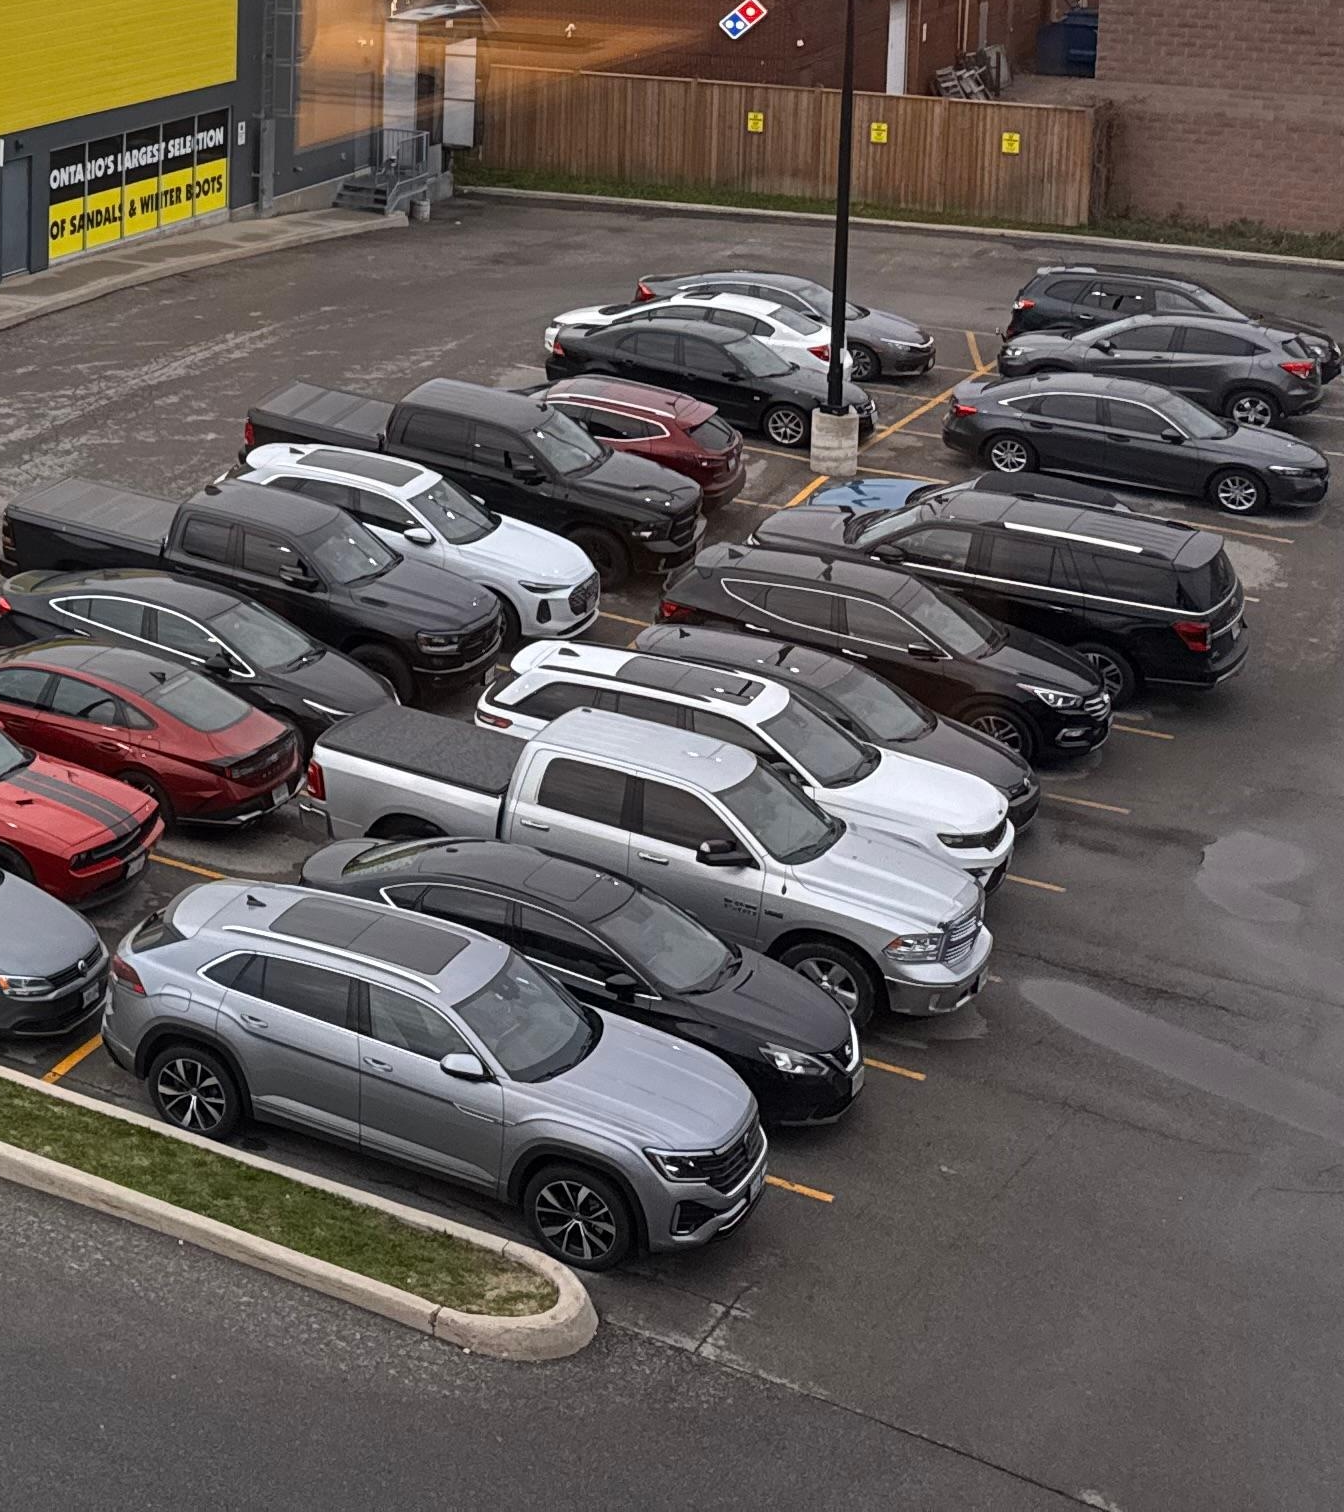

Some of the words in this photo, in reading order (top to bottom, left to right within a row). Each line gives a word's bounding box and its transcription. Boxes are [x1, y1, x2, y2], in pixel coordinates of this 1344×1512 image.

[49, 154, 115, 190] ONTARIO'S
[50, 218, 66, 240] OF
[69, 203, 123, 235] SANDALS
[128, 199, 137, 218] &
[139, 186, 182, 215] WINTER
[185, 174, 223, 200] BOOTS
